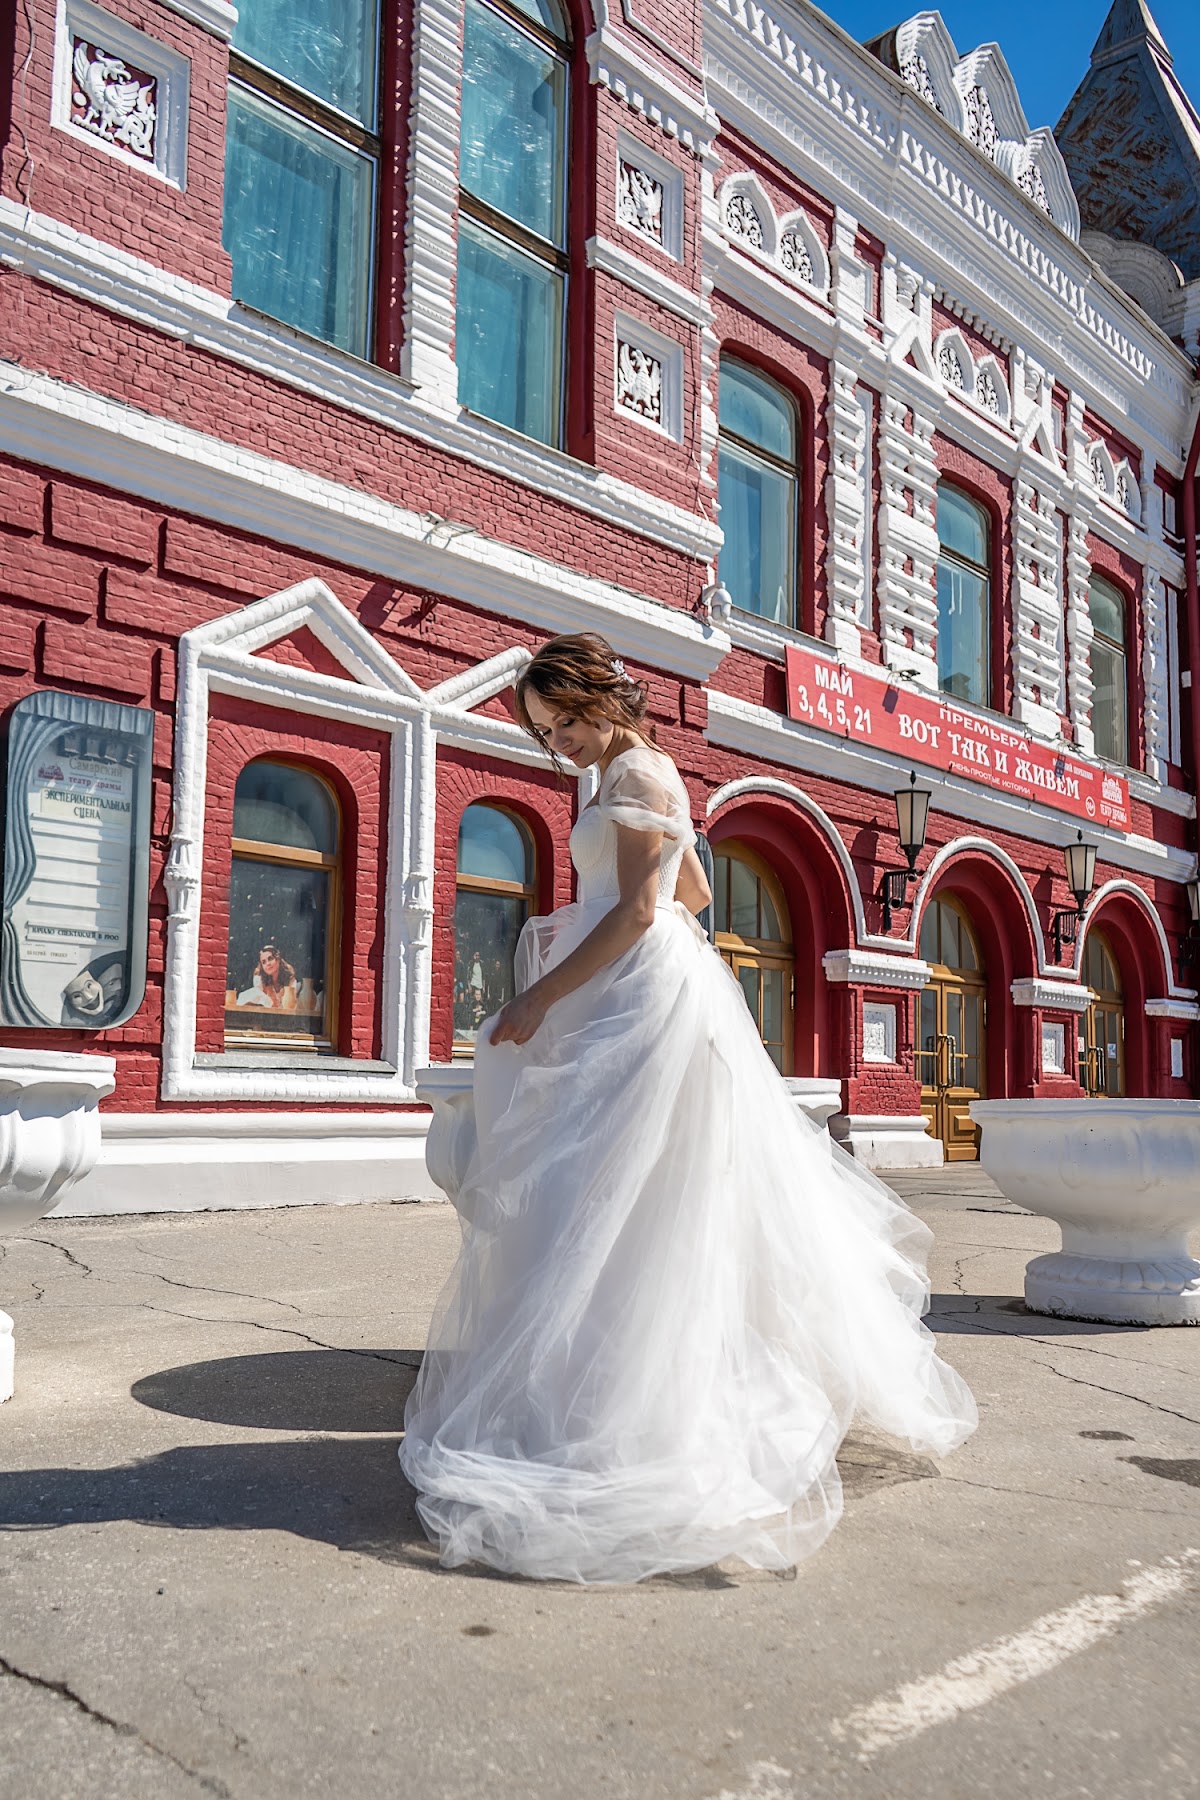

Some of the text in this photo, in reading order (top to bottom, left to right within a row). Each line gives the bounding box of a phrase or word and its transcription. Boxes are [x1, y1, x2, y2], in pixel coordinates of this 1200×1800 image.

[814, 663, 854, 698] МАЙ
[797, 684, 872, 734] 3, 4, 5, 21
[939, 707, 1030, 754] ПРЕМЬЕРА
[69, 757, 123, 778] Самарский
[898, 713, 941, 749] ВОТ
[947, 730, 991, 767] ТАК
[993, 749, 1009, 775] И
[1015, 756, 1080, 801] ЖИВЕМ
[68, 775, 92, 787] театр
[948, 760, 1031, 795] ОЧЕНЬ ПРОСТЫЕ ИСТОРИИ
[44, 789, 131, 813] ЭКСПЕРИМЕНТАЛЬНАЯ
[73, 806, 101, 820] СЦЕНА
